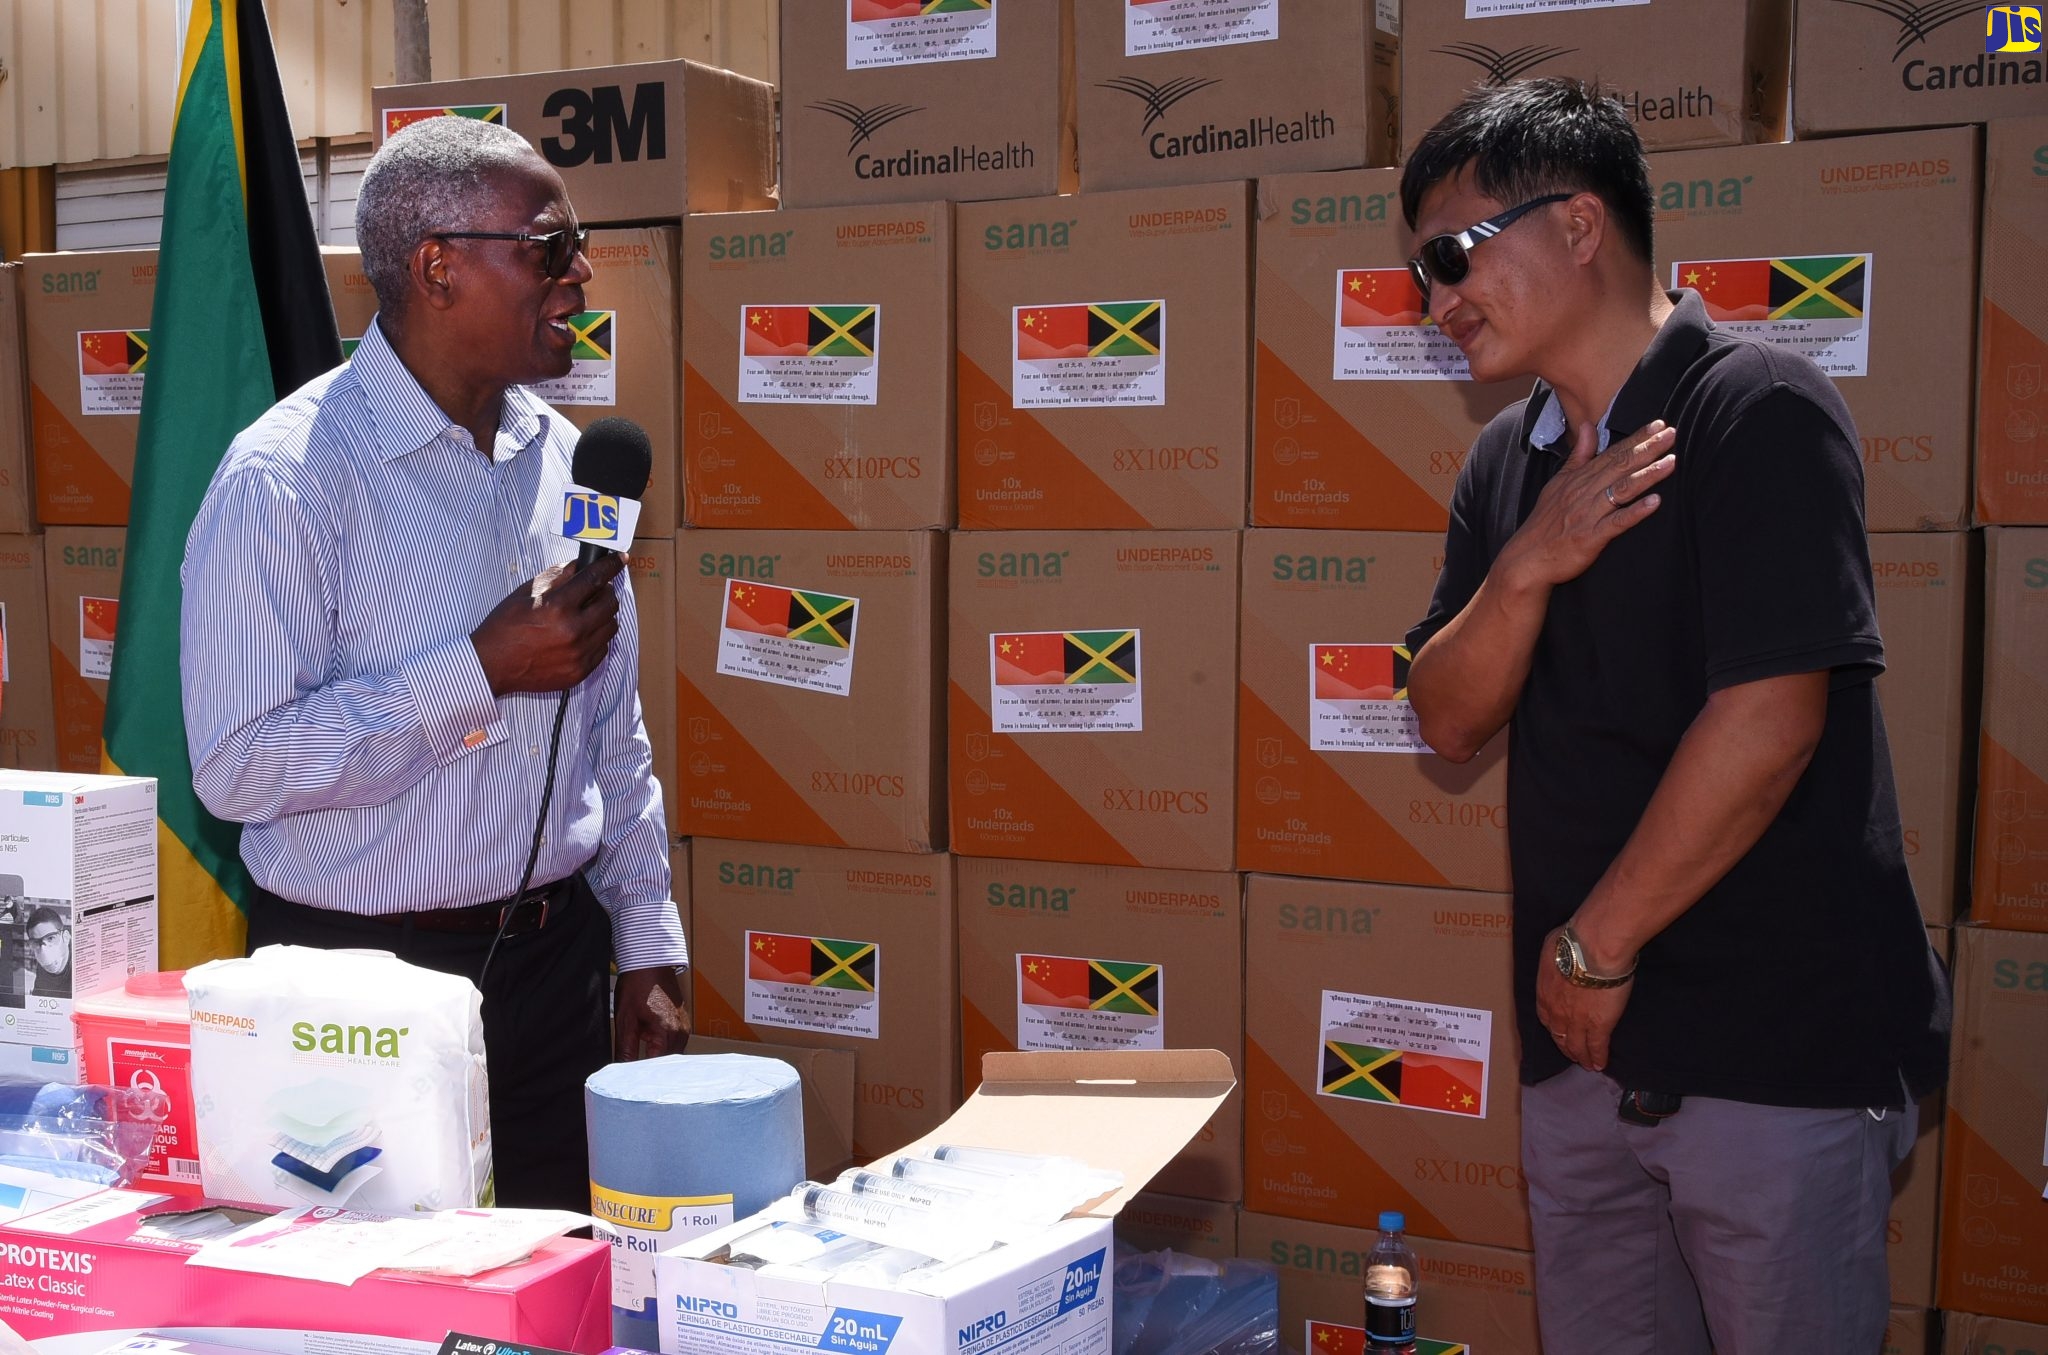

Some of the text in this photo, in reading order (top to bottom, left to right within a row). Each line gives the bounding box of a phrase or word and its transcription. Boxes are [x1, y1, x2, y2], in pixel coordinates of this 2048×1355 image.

[541, 81, 666, 168] 3M
[1821, 160, 1949, 184] UNDERPADS
[1660, 176, 1753, 210] ana
[1129, 208, 1226, 228] UNDERPADS
[1291, 192, 1395, 224] sana
[836, 221, 925, 239] UNDERPADS
[984, 219, 1077, 250] sana
[710, 230, 794, 260] sana
[42, 271, 102, 294] sana
[824, 456, 921, 479] 8X10PCS
[1113, 446, 1219, 471] 8X10PCS
[700, 494, 761, 506] Underpads
[976, 488, 1043, 500] Underpads
[1274, 491, 1349, 503] Underpads
[63, 545, 122, 568] sana
[700, 553, 781, 578] sana
[826, 555, 911, 568] UNDERPADS
[978, 551, 1069, 577] sana
[1116, 548, 1213, 562] UNDERPADS
[1273, 554, 1376, 583] sana
[811, 771, 904, 798] 8X10PCS
[46, 795, 59, 803] N95
[75, 796, 84, 804] 3M
[691, 798, 751, 811] Underpads
[1103, 789, 1208, 814] 8X10PCS
[967, 818, 1034, 832] Underpads
[1409, 801, 1507, 829] 8X10PC
[1257, 828, 1331, 845] Underpads
[719, 862, 800, 890] sana
[846, 871, 931, 888] UNDERPADS
[987, 883, 1076, 912] sana
[1126, 891, 1220, 909] UNDERPADS
[1279, 904, 1381, 934] sana
[292, 1021, 409, 1058] sana
[682, 1215, 717, 1226] 1 Roll
[627, 1236, 657, 1252] Roll
[1270, 1240, 1367, 1276] sana
[1419, 1257, 1525, 1285] UNDERPADS
[38, 1275, 85, 1297] Classic
[1065, 1285, 1092, 1304] Sin Aguja
[1962, 1271, 2048, 1295] Underpad
[676, 1294, 737, 1319] NIPRO
[678, 1313, 710, 1327] JERINGA
[711, 1318, 722, 1327] DE
[724, 1321, 761, 1335] PLASTICO
[763, 1328, 817, 1344] DESECHABLE
[833, 1317, 857, 1335] 20
[959, 1310, 1006, 1345] NIPRO
[456, 1339, 482, 1352] Latex
[831, 1335, 878, 1351] Sin Aguja
